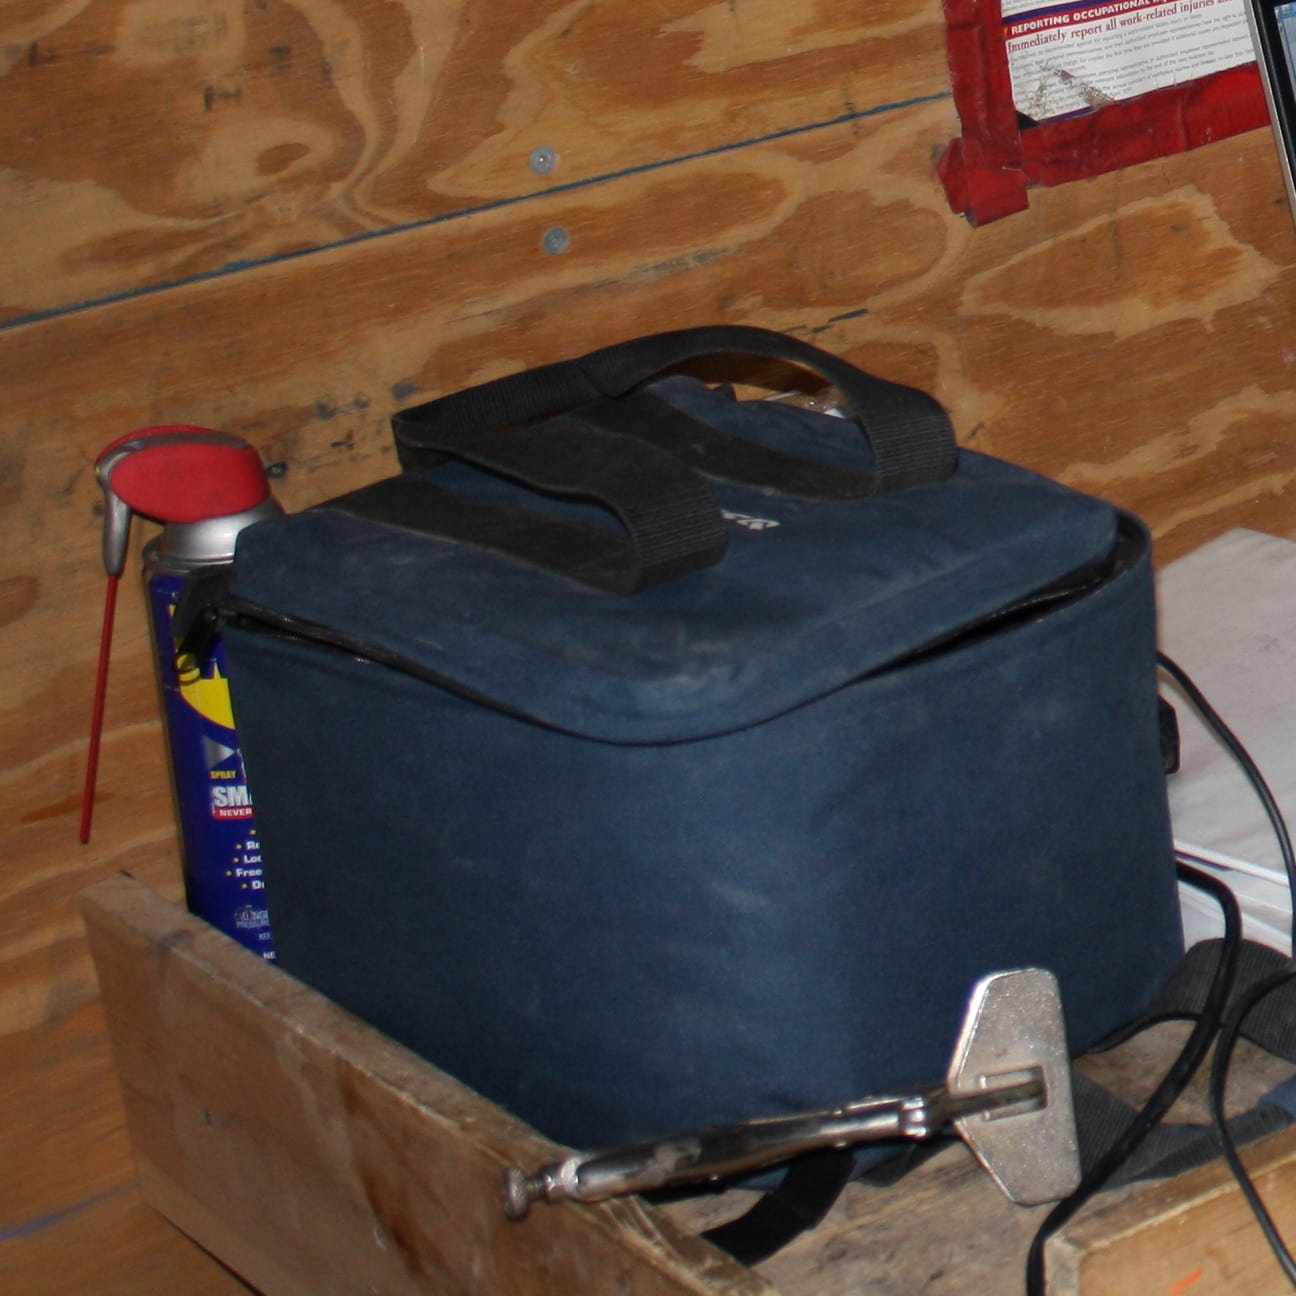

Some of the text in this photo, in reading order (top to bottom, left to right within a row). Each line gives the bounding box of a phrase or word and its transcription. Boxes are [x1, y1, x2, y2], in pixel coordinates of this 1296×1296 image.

[1008, 31, 1065, 53] Immediately
[1071, 26, 1103, 41] report
[1106, 20, 1117, 31] all
[1121, 7, 1177, 28] work-related
[1011, 14, 1069, 35] REPORTING
[210, 770, 236, 779] SPRAY
[220, 808, 252, 817] NEVER
